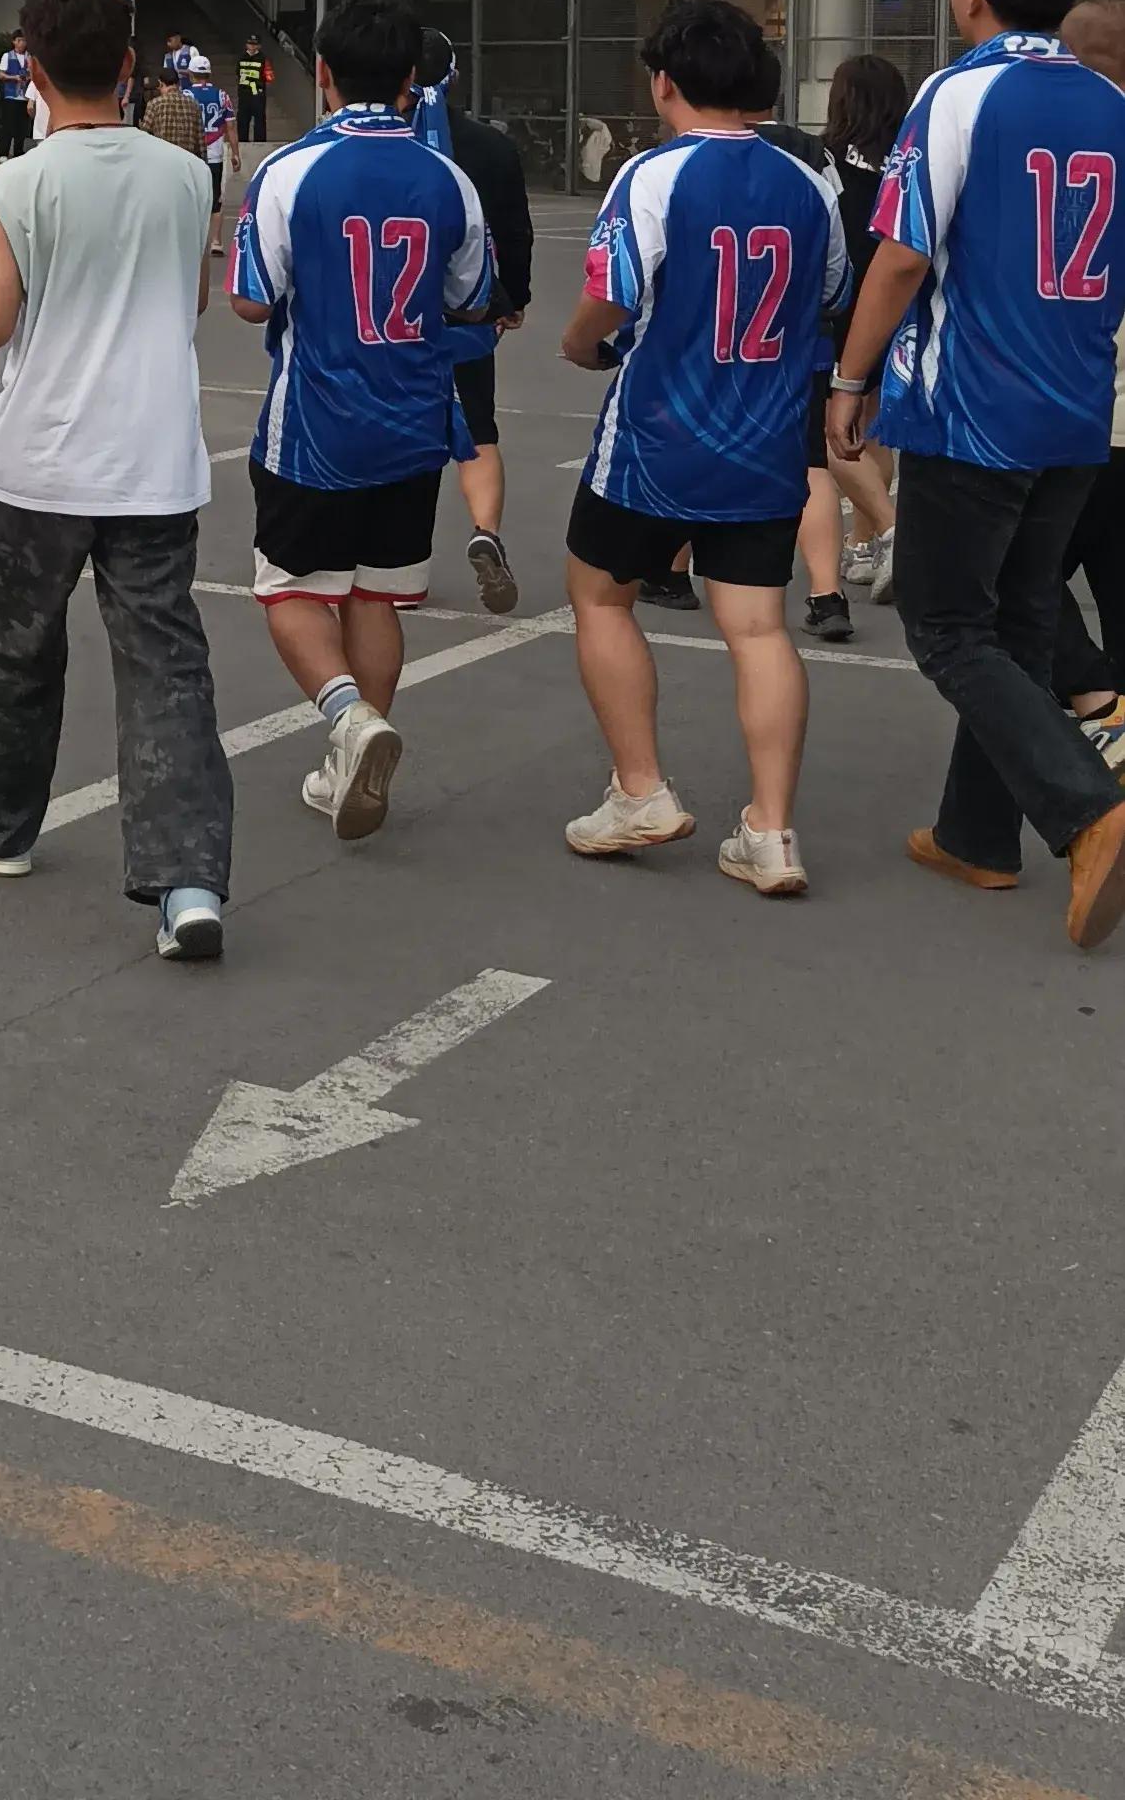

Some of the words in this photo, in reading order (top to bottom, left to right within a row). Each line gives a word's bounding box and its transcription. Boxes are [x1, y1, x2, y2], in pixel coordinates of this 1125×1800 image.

[342, 215, 430, 345] 12
[1027, 148, 1116, 301] 12
[710, 225, 793, 364] 12
